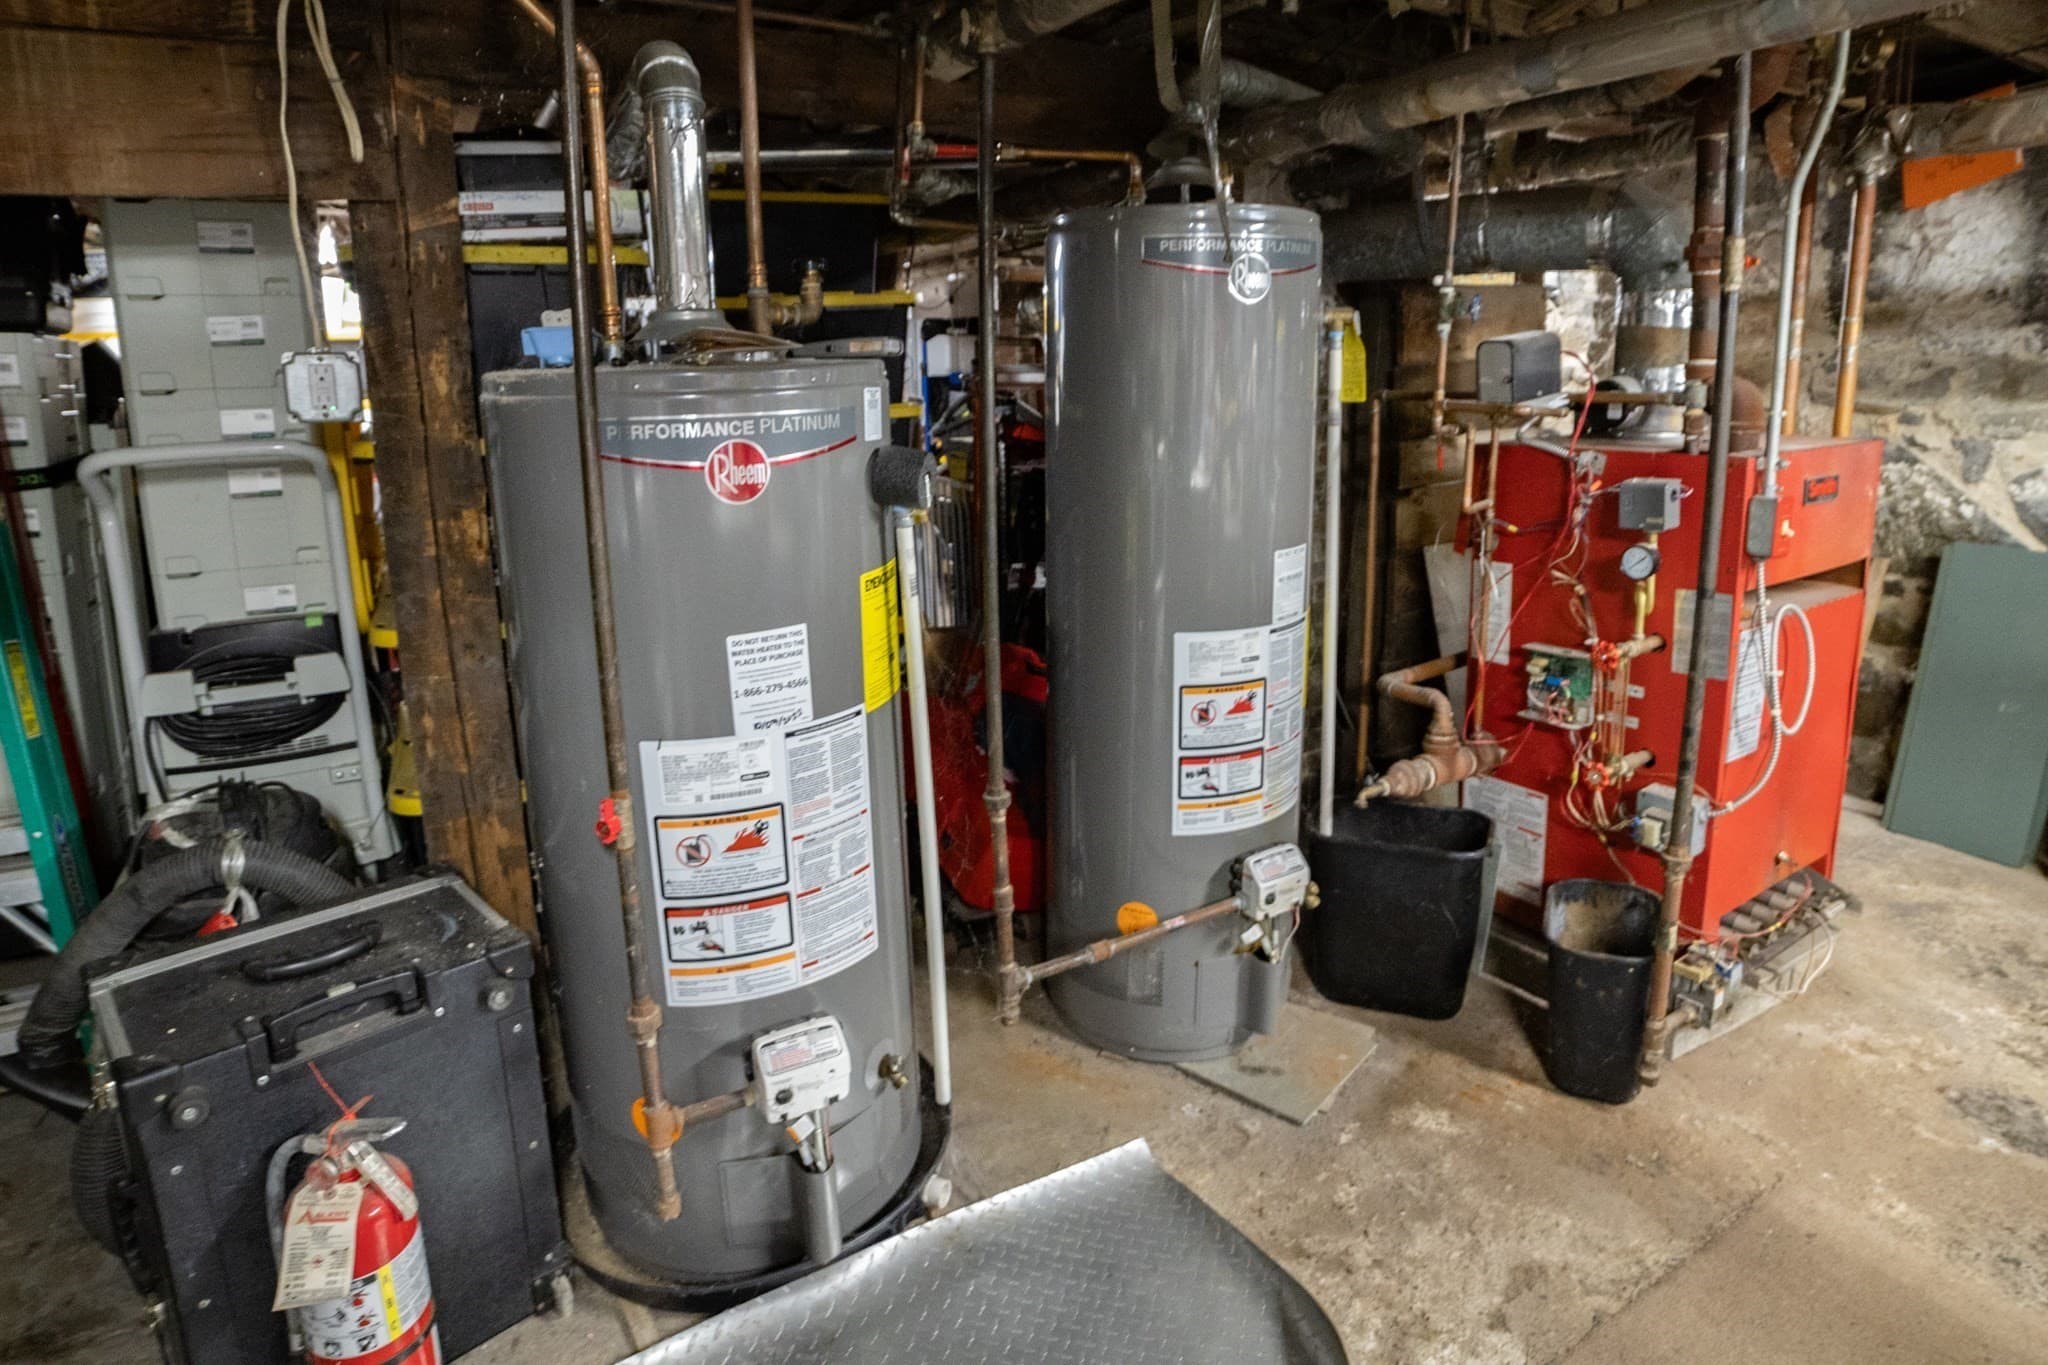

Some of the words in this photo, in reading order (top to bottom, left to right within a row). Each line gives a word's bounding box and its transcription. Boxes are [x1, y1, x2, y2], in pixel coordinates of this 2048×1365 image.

[1265, 239, 1312, 254] PLATINUM
[606, 419, 754, 440] PRFORMANCE
[759, 412, 840, 434] PLATINUM
[714, 442, 767, 495] Rheem
